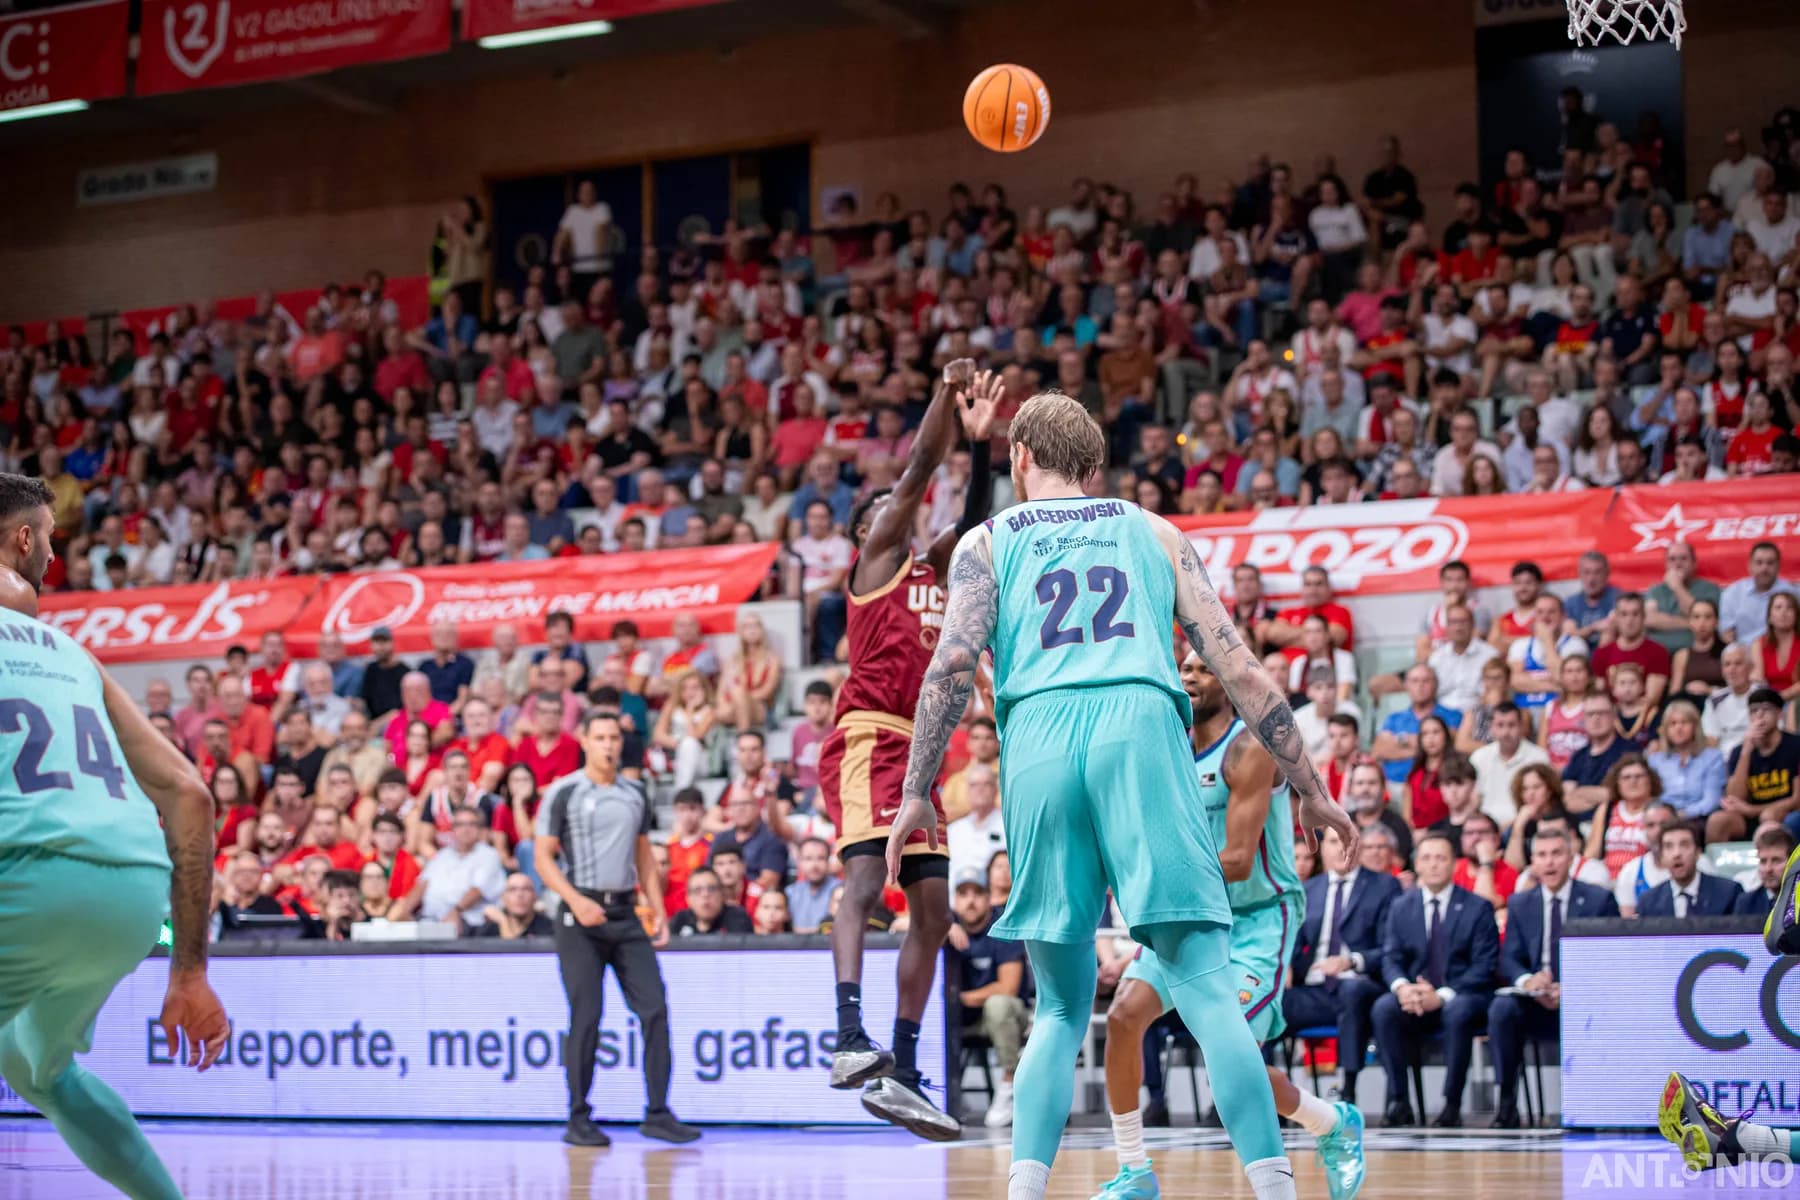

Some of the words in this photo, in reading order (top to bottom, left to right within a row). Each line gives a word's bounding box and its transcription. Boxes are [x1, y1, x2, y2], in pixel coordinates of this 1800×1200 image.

[1006, 502, 1126, 532] BALCEROWSKI
[1707, 513, 1800, 540] EST
[1058, 540, 1118, 552] FOUNDATION
[594, 584, 720, 612] MURCIA
[1035, 565, 1135, 650] 22
[0, 697, 127, 800] 24
